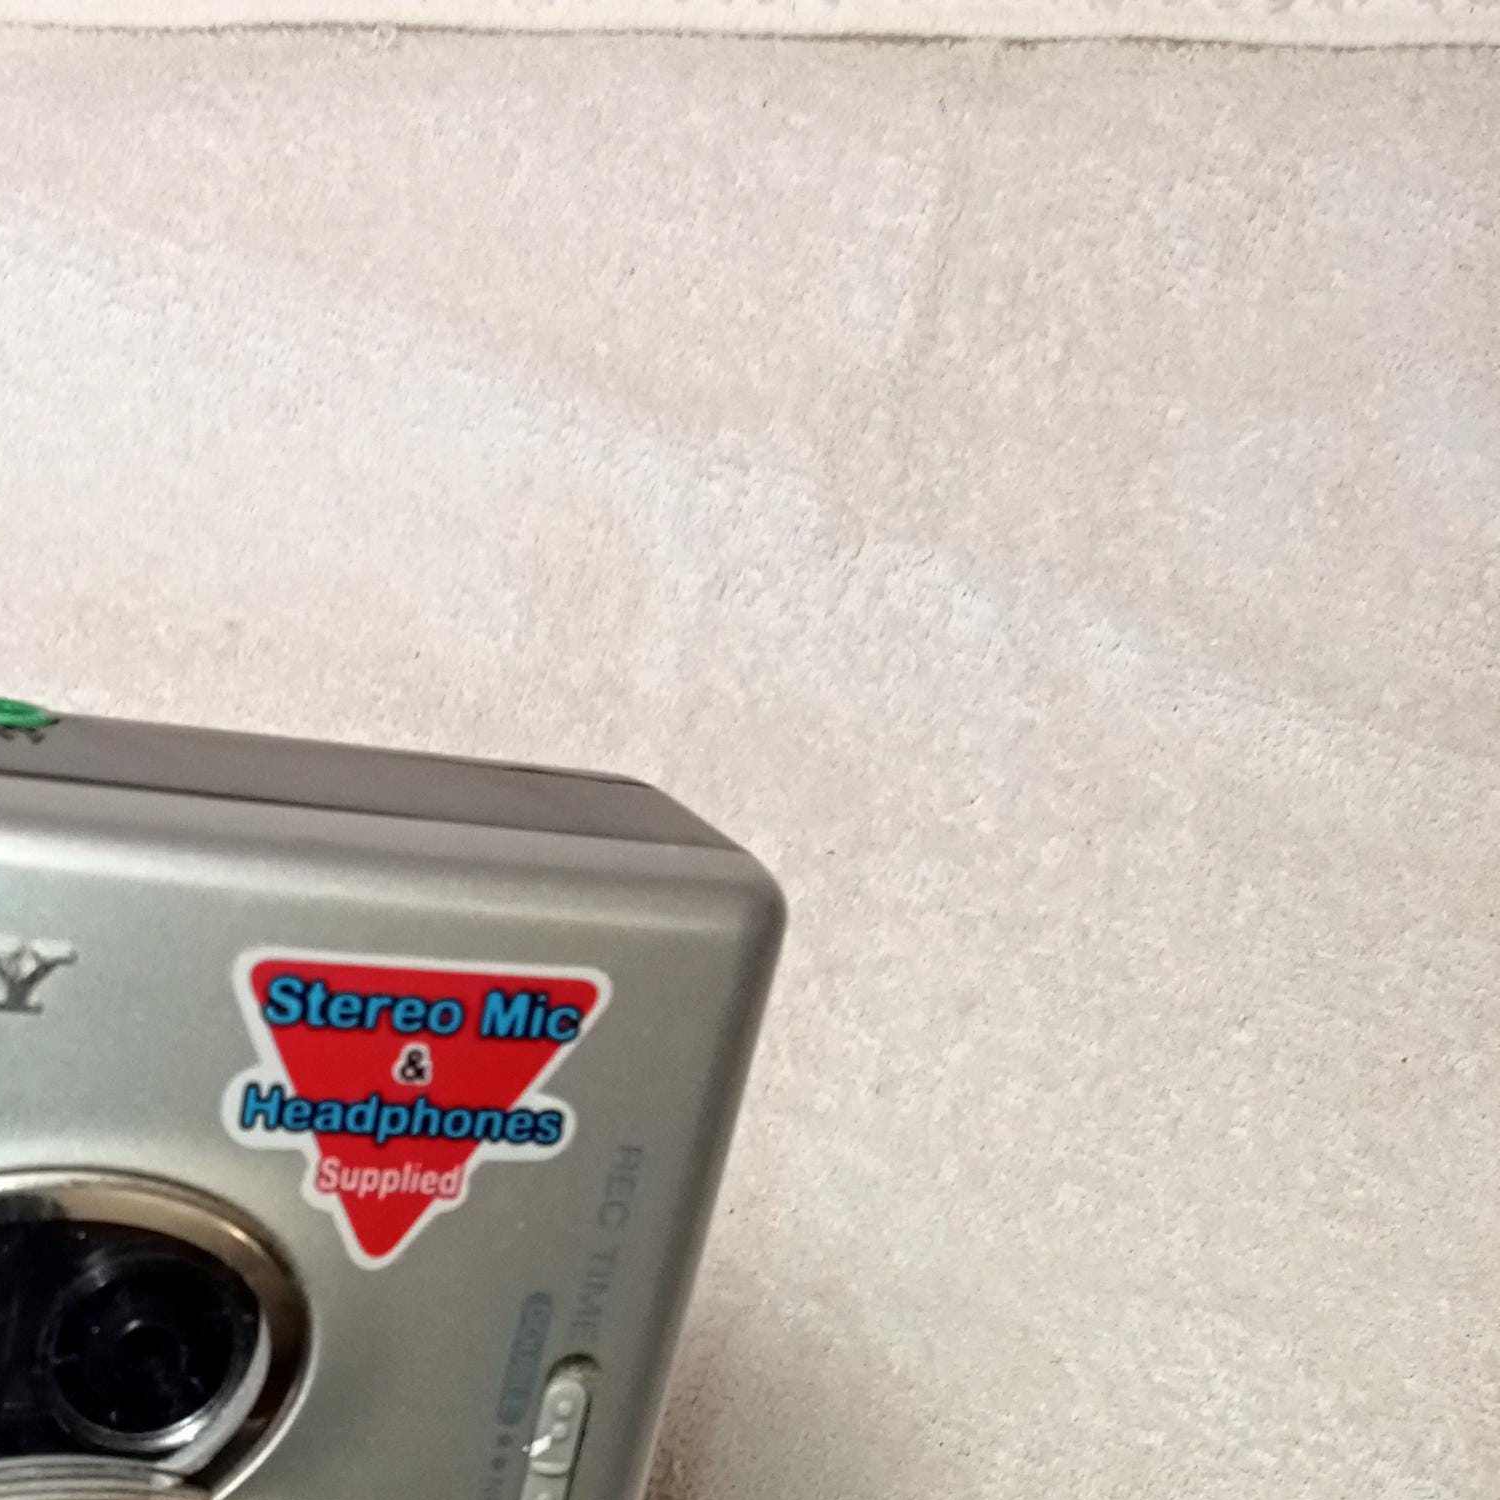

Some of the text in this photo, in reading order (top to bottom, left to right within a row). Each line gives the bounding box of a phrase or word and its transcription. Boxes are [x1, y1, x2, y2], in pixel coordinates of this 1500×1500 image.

[263, 973, 583, 1042] Stereo Mic
[398, 1048, 428, 1083] &
[240, 1083, 565, 1145] Headphones
[316, 1156, 463, 1199] Supplied
[597, 1144, 644, 1231] REC
